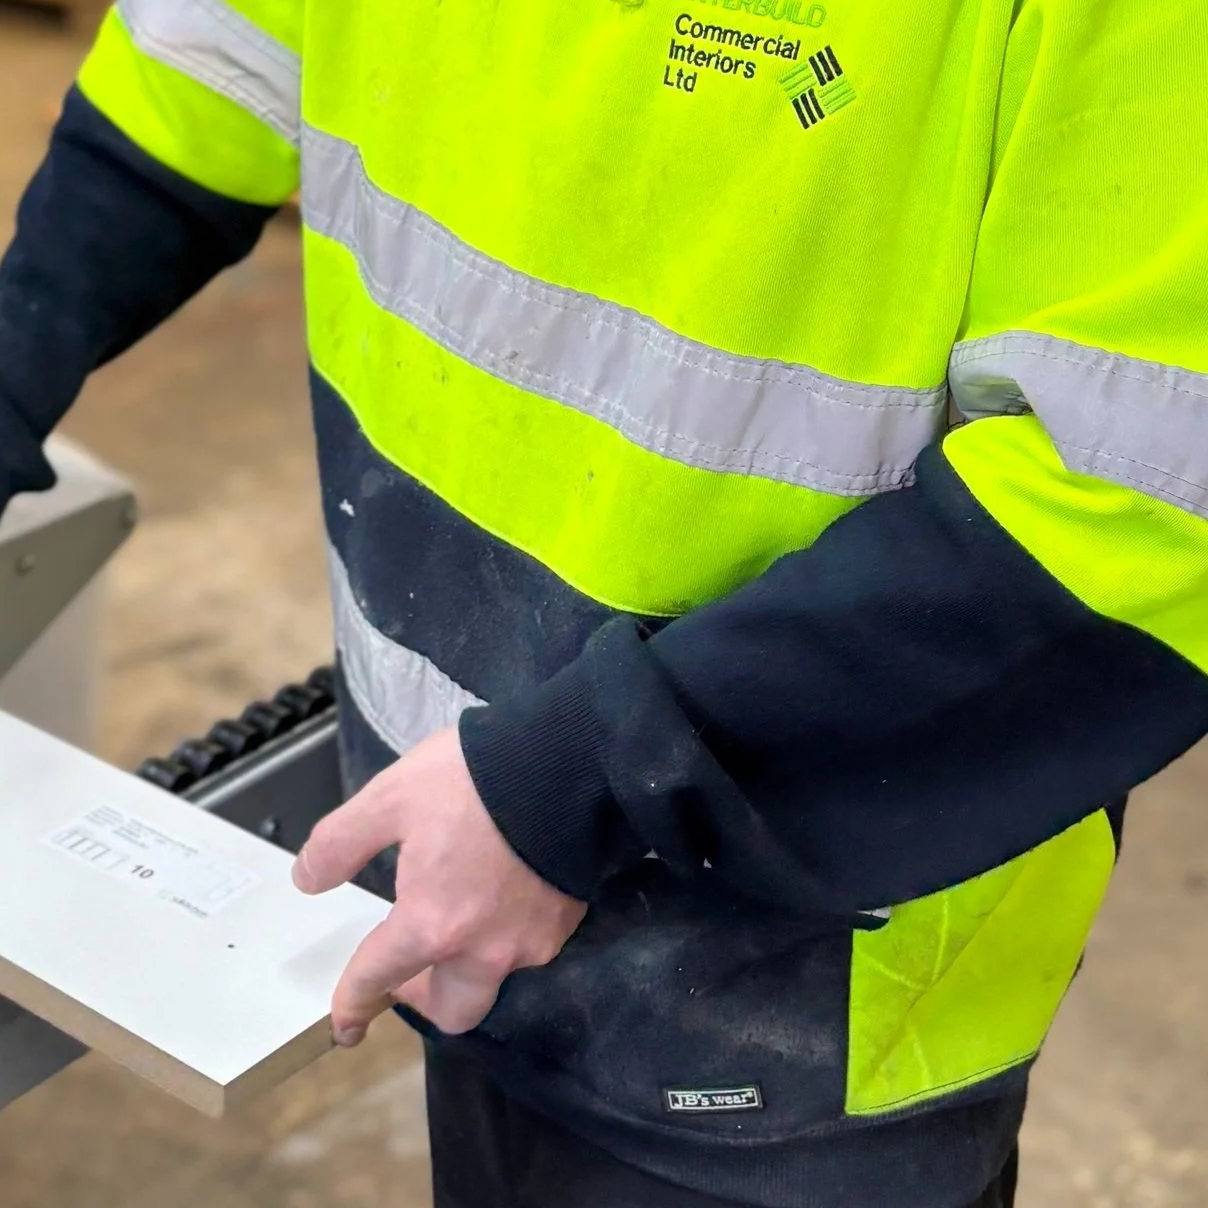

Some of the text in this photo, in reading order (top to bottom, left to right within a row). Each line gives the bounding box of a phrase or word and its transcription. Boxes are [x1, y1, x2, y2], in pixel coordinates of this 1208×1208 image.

[675, 13, 801, 61] Commercial
[669, 39, 757, 79] Interiors
[663, 65, 698, 93] Ltd
[131, 864, 155, 879] 10
[674, 1094, 710, 1108] JB's
